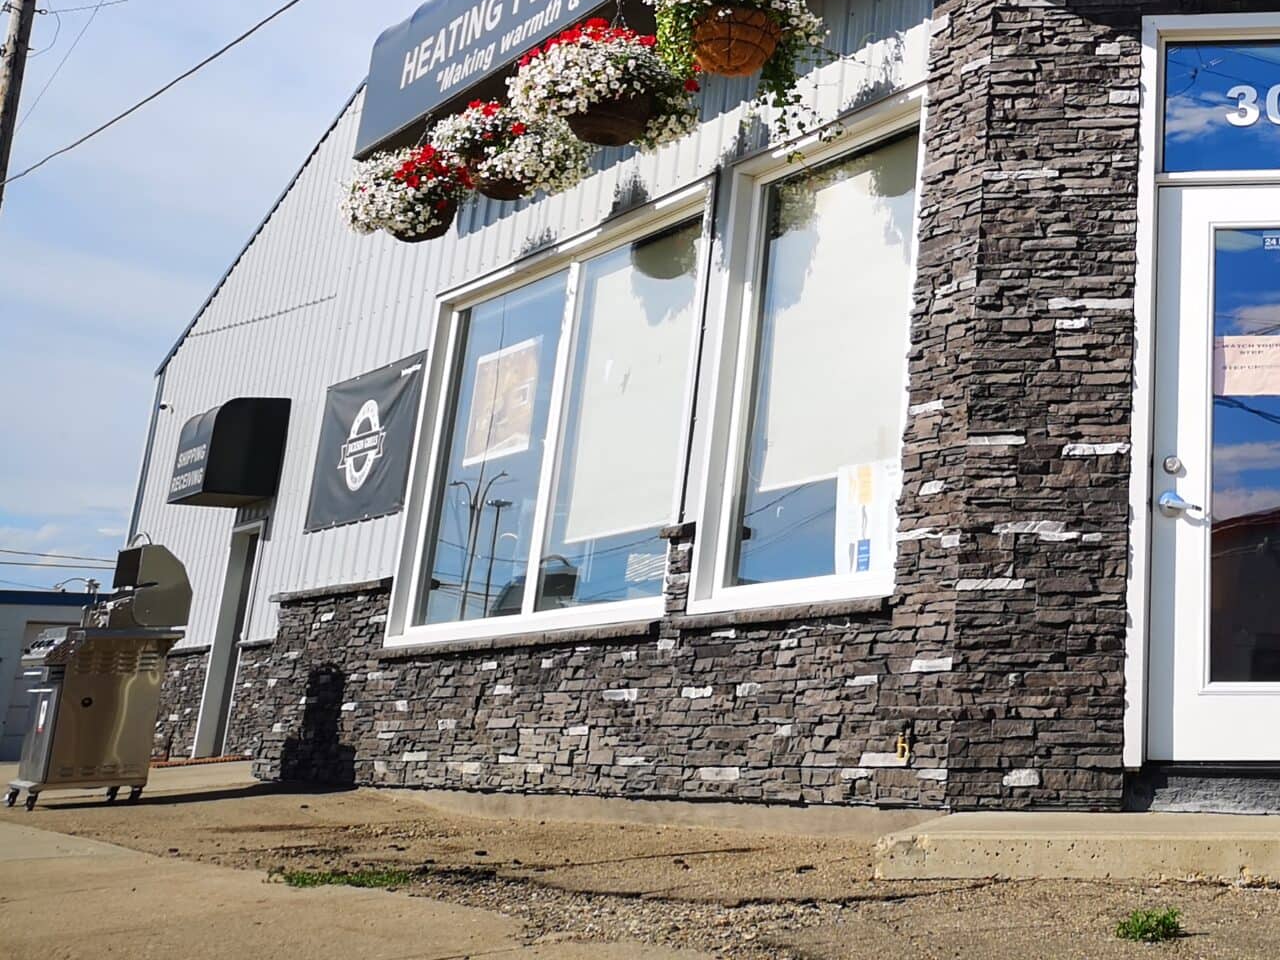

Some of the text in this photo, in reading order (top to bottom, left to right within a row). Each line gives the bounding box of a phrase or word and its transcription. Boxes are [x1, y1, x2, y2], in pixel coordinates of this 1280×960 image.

[437, 43, 495, 93] "Making
[1265, 238, 1277, 246] 24
[170, 467, 204, 493] RECEIVING
